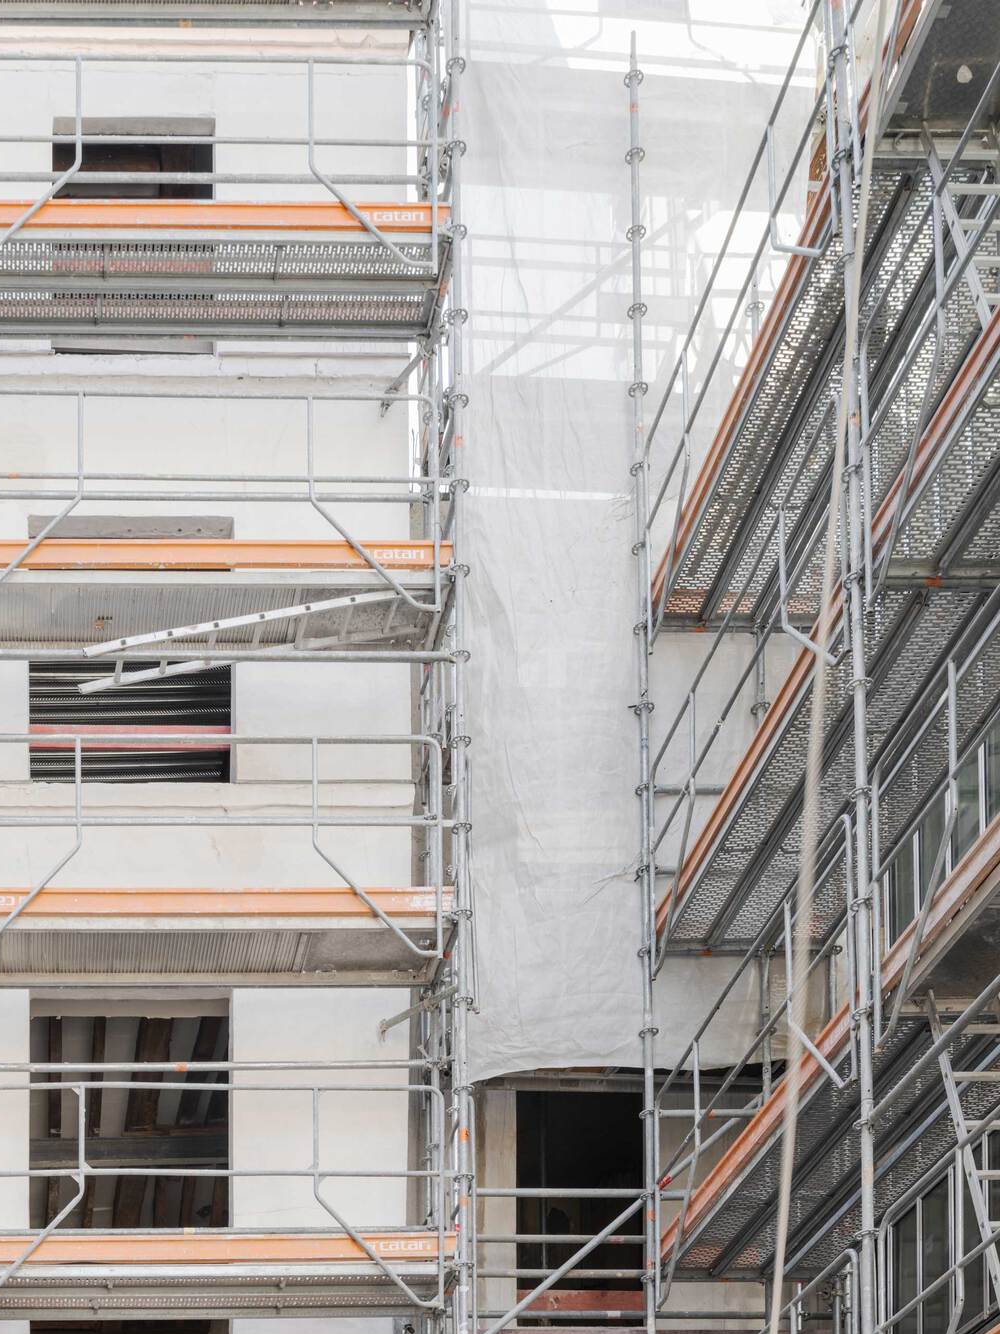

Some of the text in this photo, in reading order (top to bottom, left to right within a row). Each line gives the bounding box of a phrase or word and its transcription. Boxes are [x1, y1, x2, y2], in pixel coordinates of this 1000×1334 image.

[373, 211, 424, 222] catari
[373, 549, 424, 559] catari
[379, 1240, 431, 1251] catari
